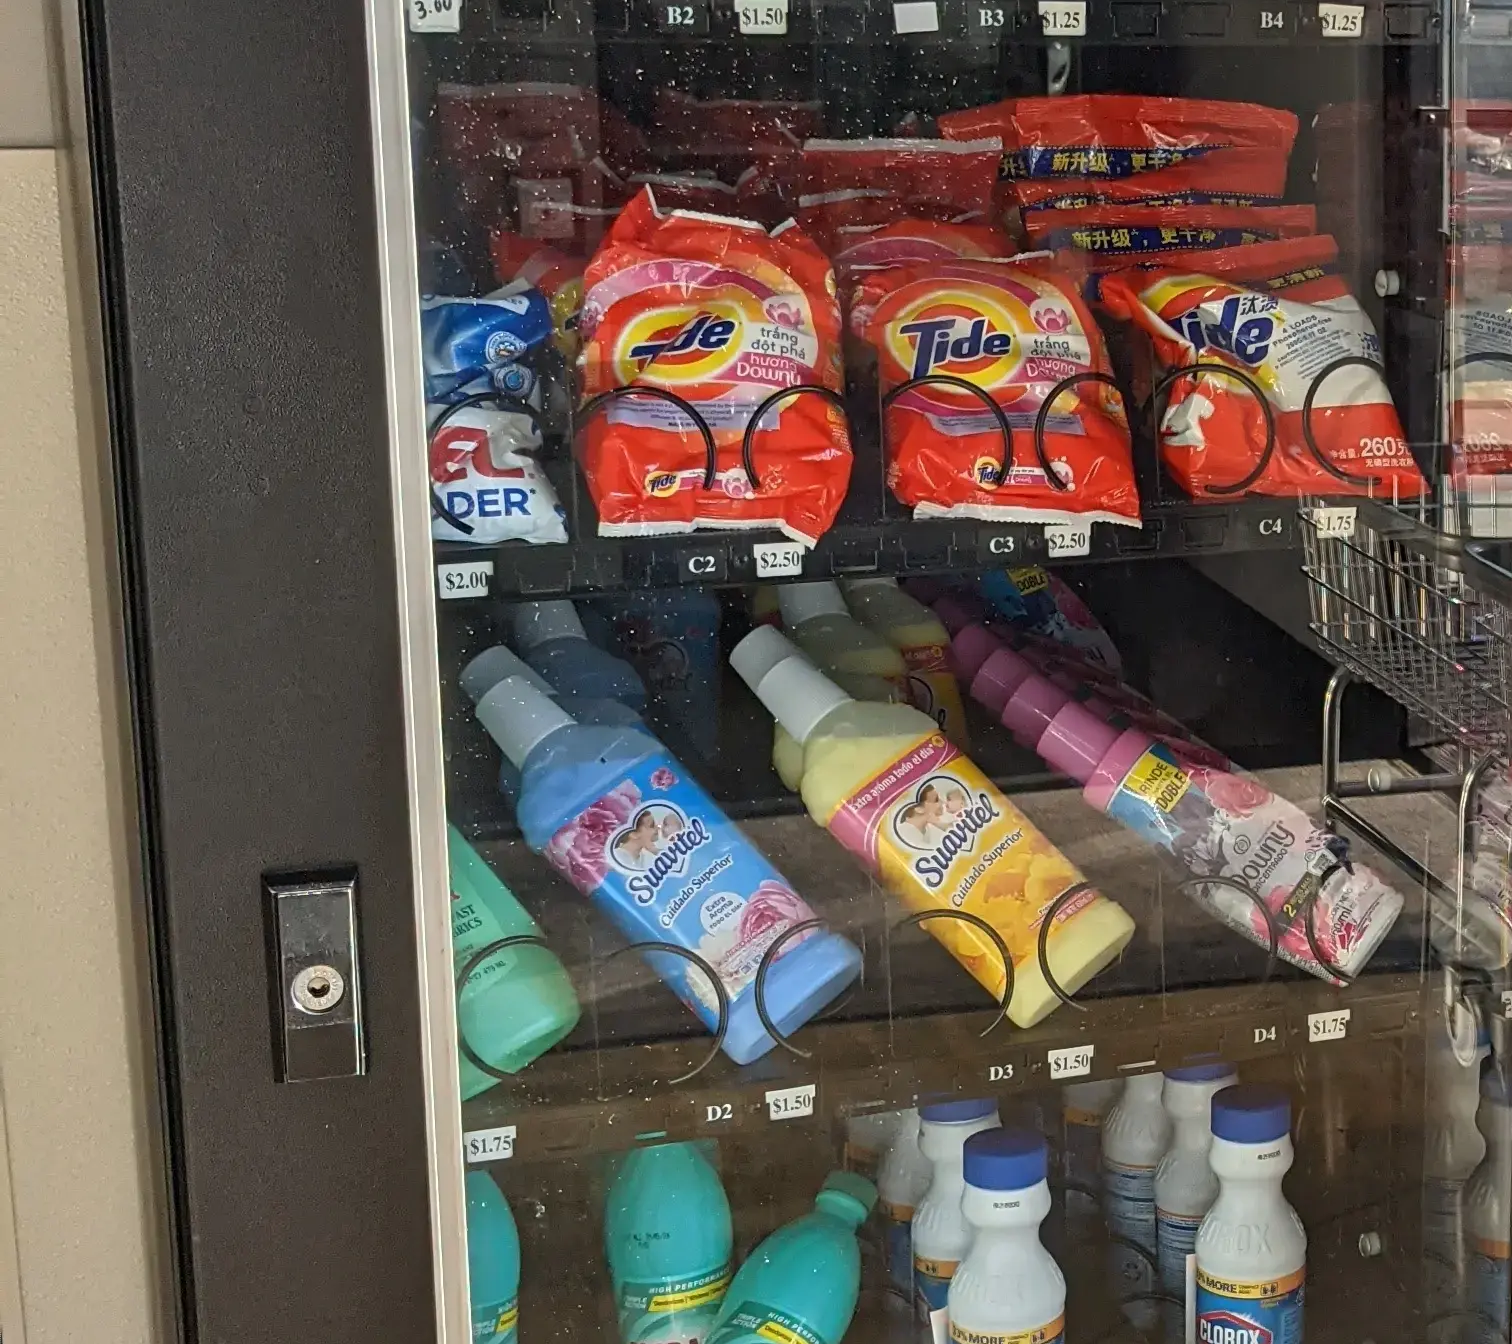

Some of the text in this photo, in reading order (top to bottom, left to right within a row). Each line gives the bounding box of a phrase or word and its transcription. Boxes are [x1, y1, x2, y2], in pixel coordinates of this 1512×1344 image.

[666, 6, 695, 25] B2
[741, 7, 784, 27] $1.50
[979, 9, 1005, 28] B3
[1042, 11, 1081, 29] $1.25
[1260, 11, 1284, 29] B4
[1322, 13, 1358, 32] $1.25
[760, 327, 799, 345] trắng
[900, 318, 1012, 380] Tide
[649, 472, 678, 492] Tide
[1258, 518, 1283, 535] C4
[989, 536, 1015, 553] C3
[1048, 532, 1087, 551] $2.50
[688, 555, 717, 575] C2
[760, 550, 801, 570] $2.50
[445, 570, 489, 591] $2.00
[1139, 762, 1168, 794] RINDE
[915, 793, 1000, 888] Suavitel
[628, 818, 710, 905] Suavitel
[952, 828, 1024, 908] Cuidado Superior
[661, 855, 733, 927] Cuidado Superior
[705, 896, 726, 912] Extra
[709, 900, 734, 920] Aroma
[1284, 903, 1297, 918] 2
[1254, 1026, 1277, 1044] D4
[1312, 1017, 1346, 1035] $1.75
[989, 1063, 1014, 1081] D3
[1053, 1053, 1089, 1073] $1.50
[706, 1103, 733, 1122] D2
[772, 1092, 811, 1114] $1.50
[469, 1133, 513, 1155] $1.75
[1206, 1278, 1238, 1294] MORE
